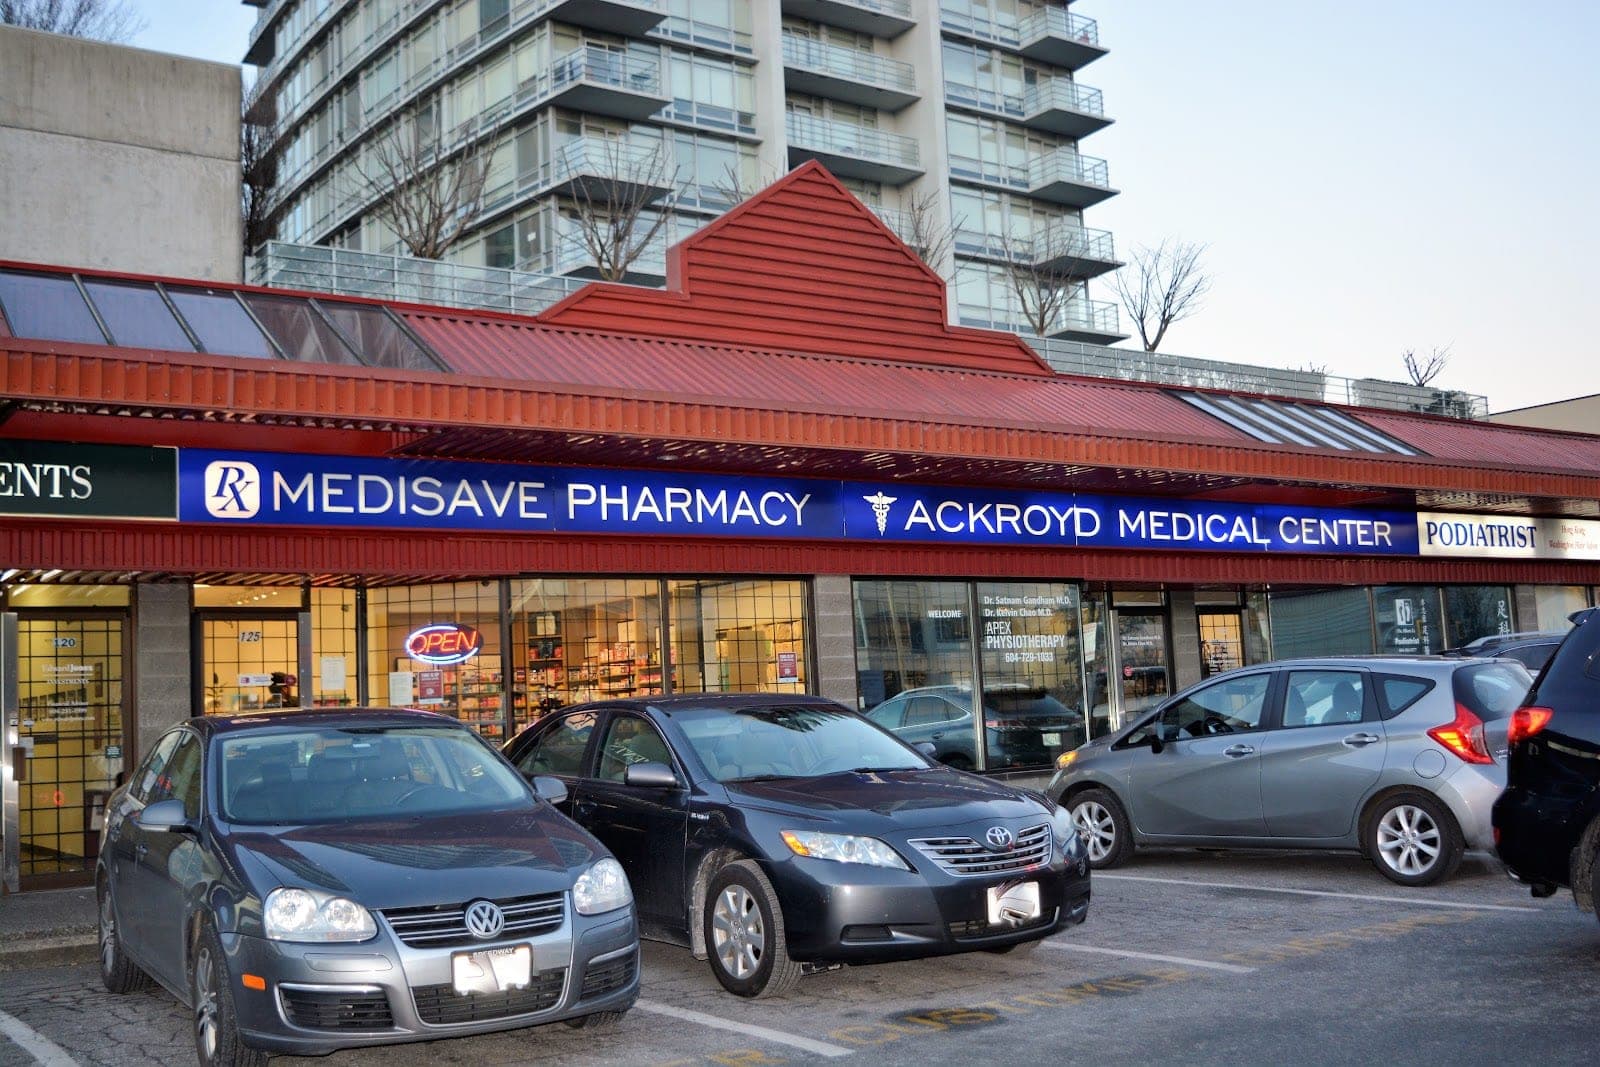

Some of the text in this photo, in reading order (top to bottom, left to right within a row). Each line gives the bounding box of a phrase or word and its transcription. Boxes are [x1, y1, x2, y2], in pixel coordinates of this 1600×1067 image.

[272, 470, 548, 519] MEDISAVE
[567, 483, 812, 527] PHARMACY
[903, 499, 1393, 547] ACKROYD MEDICAL CENTER
[1425, 521, 1537, 548] PODIATRIST
[927, 610, 962, 619] WELCOME
[986, 621, 1012, 635] APEX
[54, 638, 76, 648] 120
[240, 631, 261, 642] 125
[409, 630, 478, 655] OPEN
[986, 634, 1066, 649] PHYSIOTHERAPY
